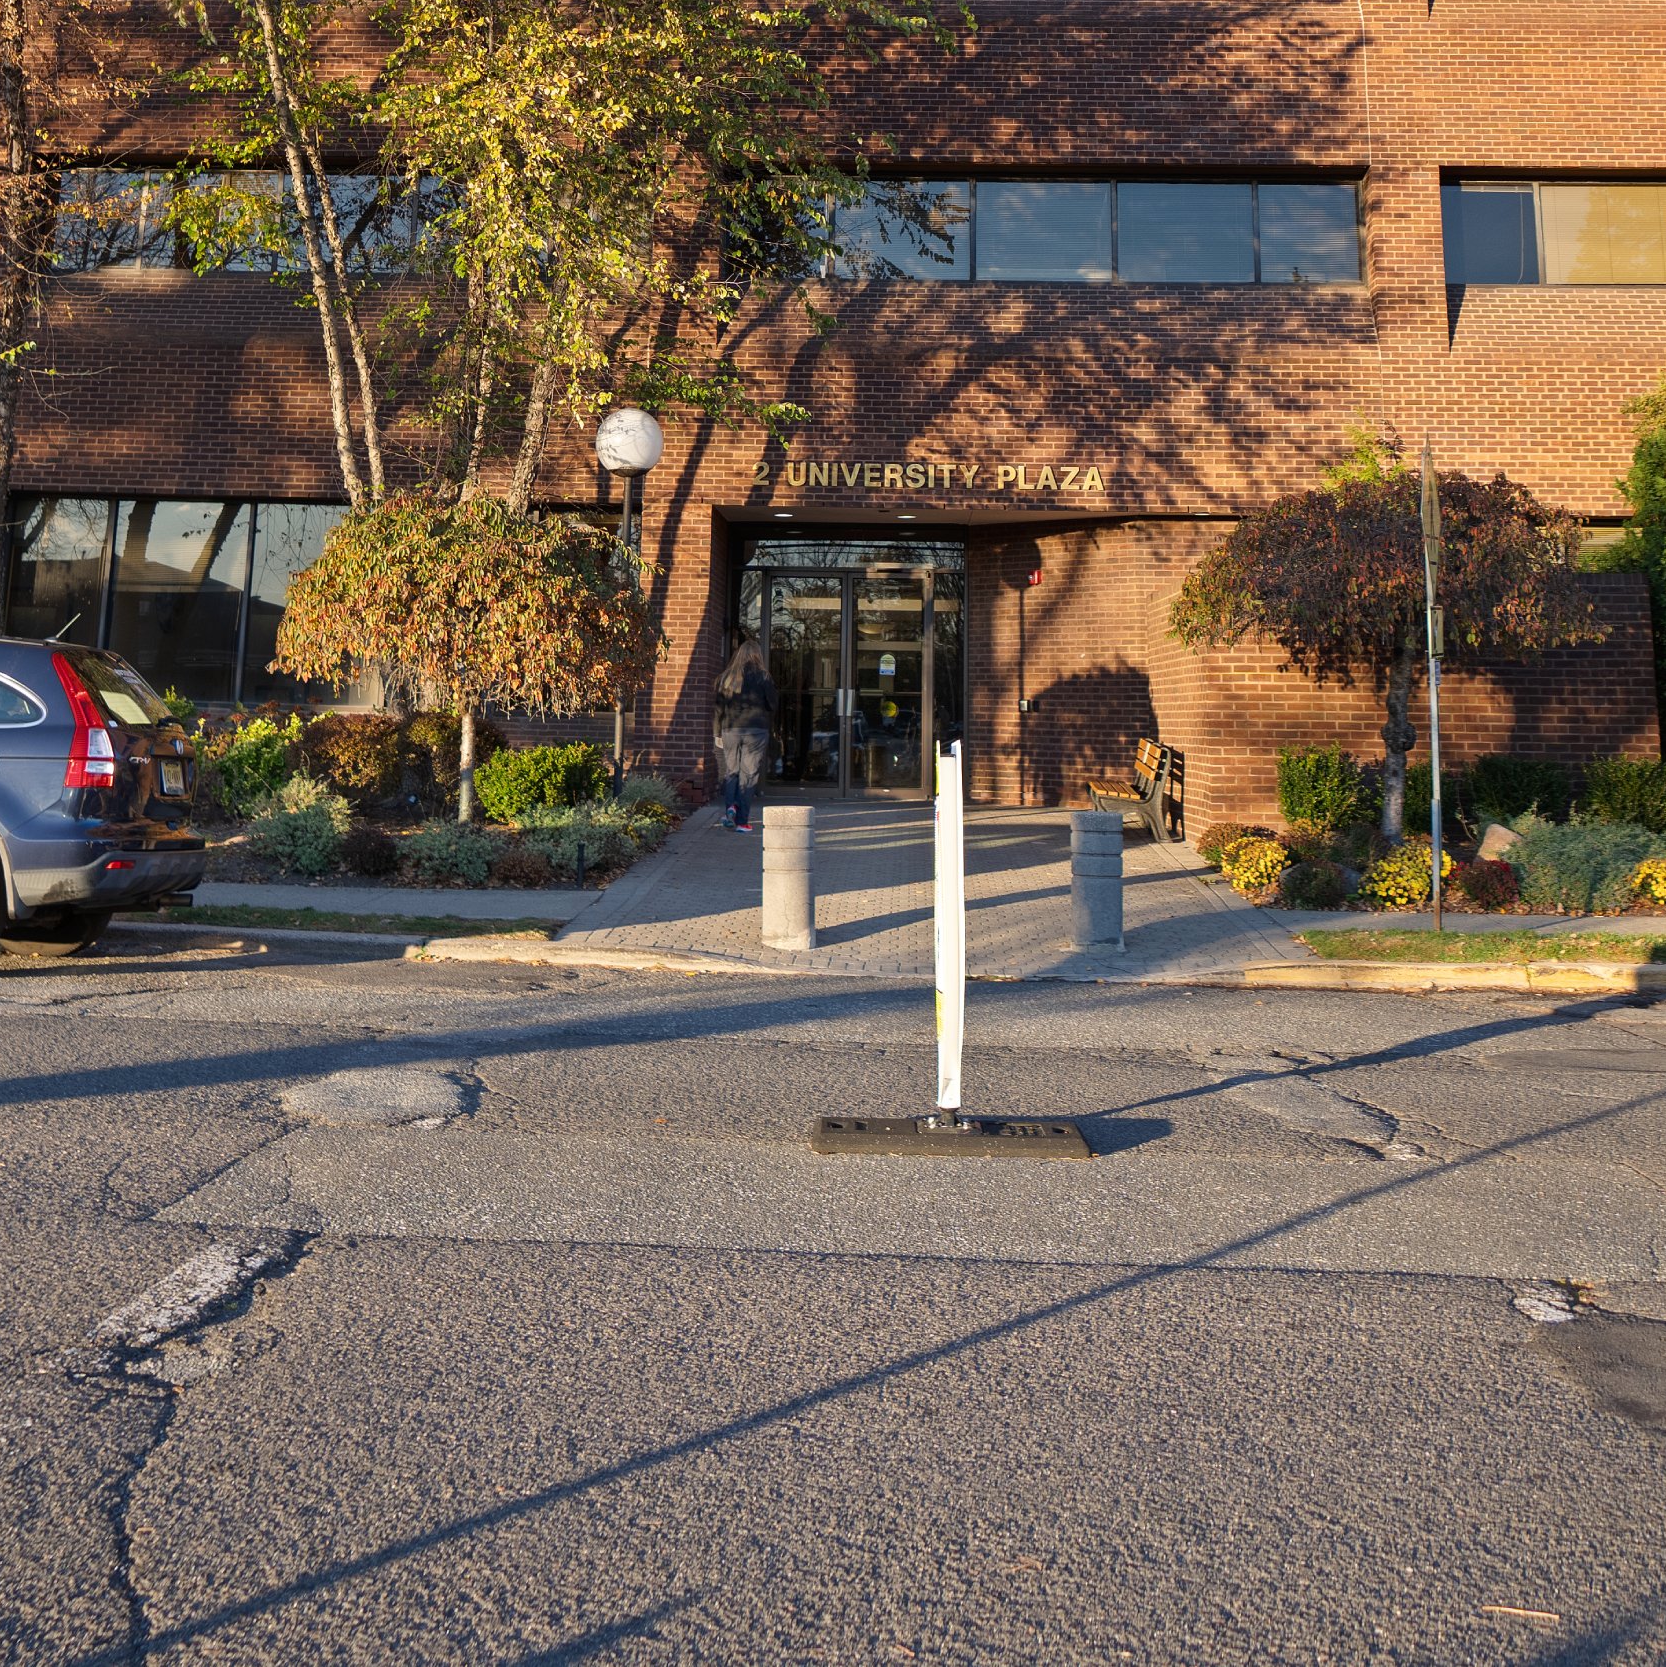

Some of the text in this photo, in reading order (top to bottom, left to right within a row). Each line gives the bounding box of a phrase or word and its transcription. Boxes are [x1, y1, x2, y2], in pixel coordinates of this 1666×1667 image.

[751, 461, 1106, 492] 2 UNIVERSITY PLAZA
